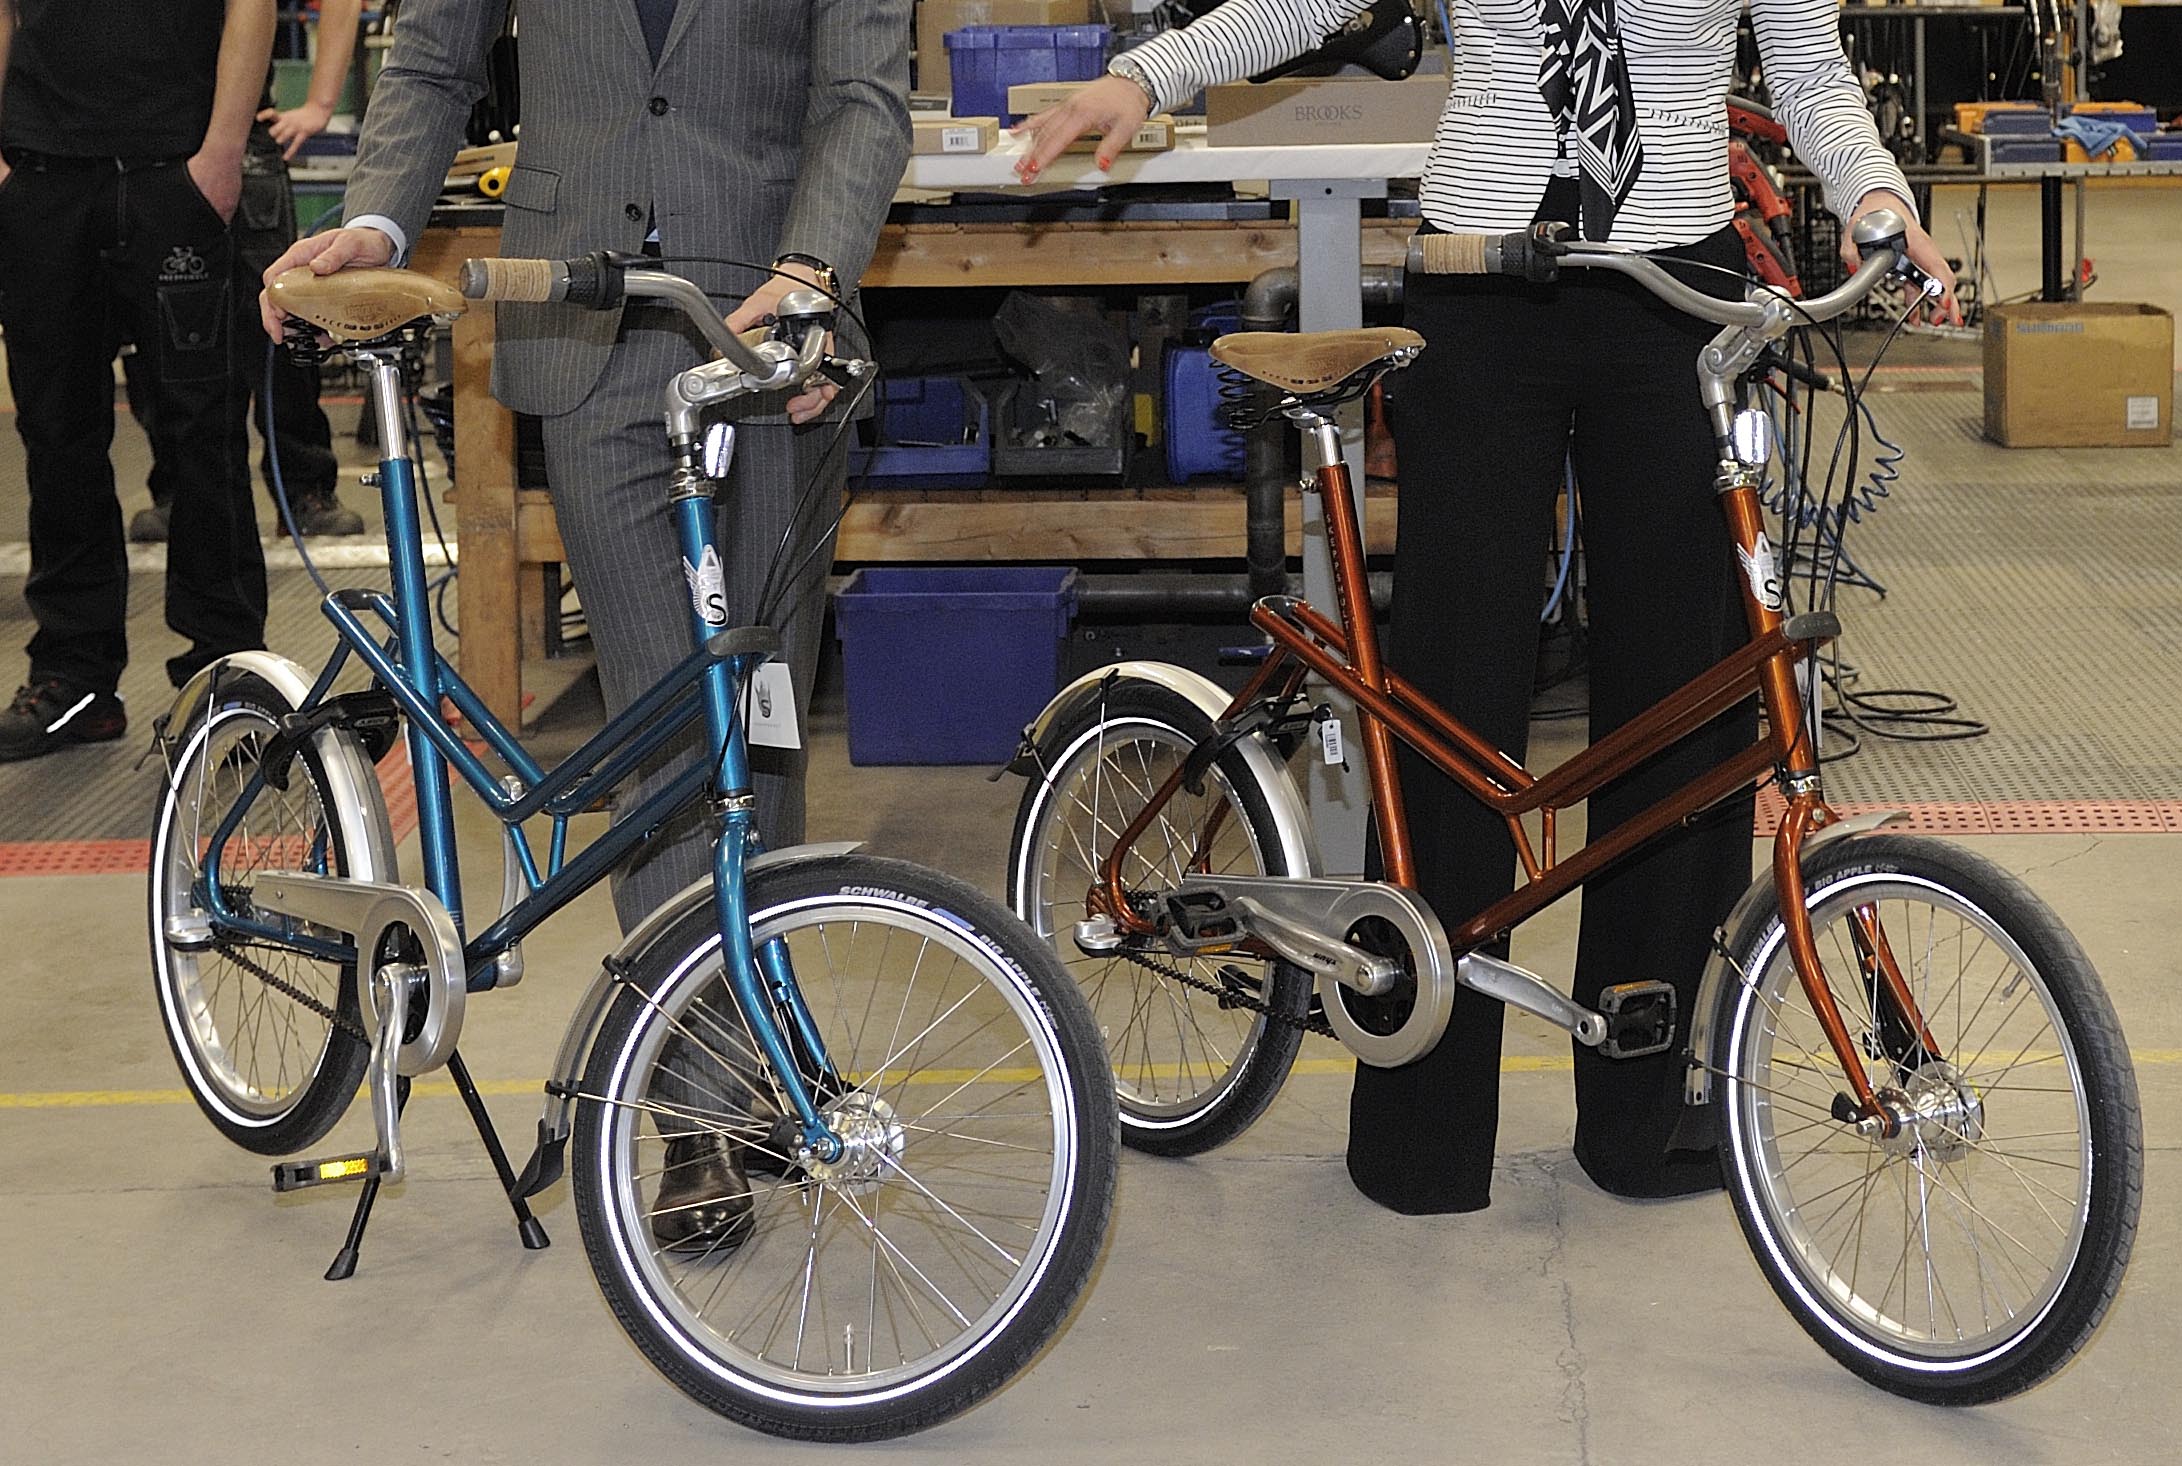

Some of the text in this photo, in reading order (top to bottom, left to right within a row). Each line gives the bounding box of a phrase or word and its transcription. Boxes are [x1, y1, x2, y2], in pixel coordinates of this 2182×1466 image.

[1295, 105, 1362, 121] BROOKS
[1326, 513, 1350, 630] SKEPPSHULT
[706, 593, 727, 626] S
[1814, 874, 1834, 891] BIG
[1836, 865, 1872, 881] APPLE
[839, 885, 929, 908] SCHWALBE
[979, 934, 1042, 996] BIG APPLE
